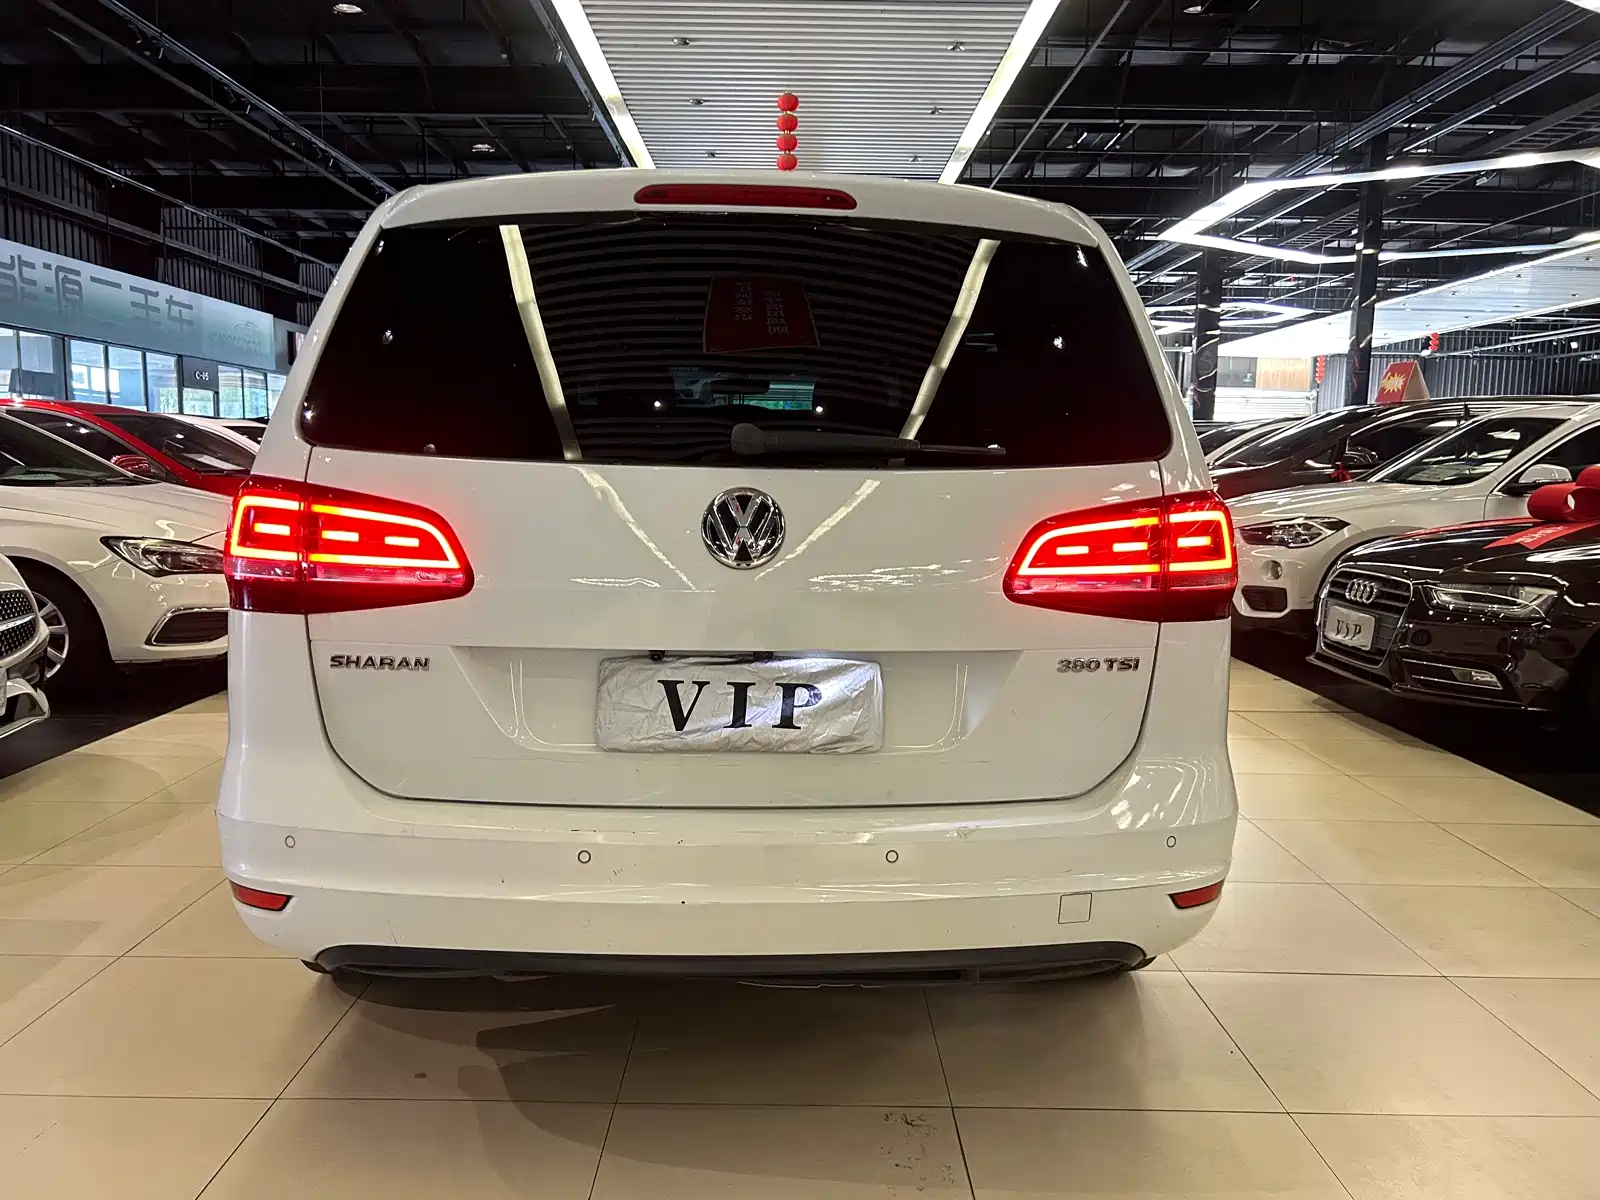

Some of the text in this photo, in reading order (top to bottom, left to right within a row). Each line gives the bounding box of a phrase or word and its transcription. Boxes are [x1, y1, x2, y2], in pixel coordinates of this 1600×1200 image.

[329, 654, 430, 671] SHARAN
[1056, 656, 1140, 673] 380 TSI
[657, 679, 823, 732] VIP
